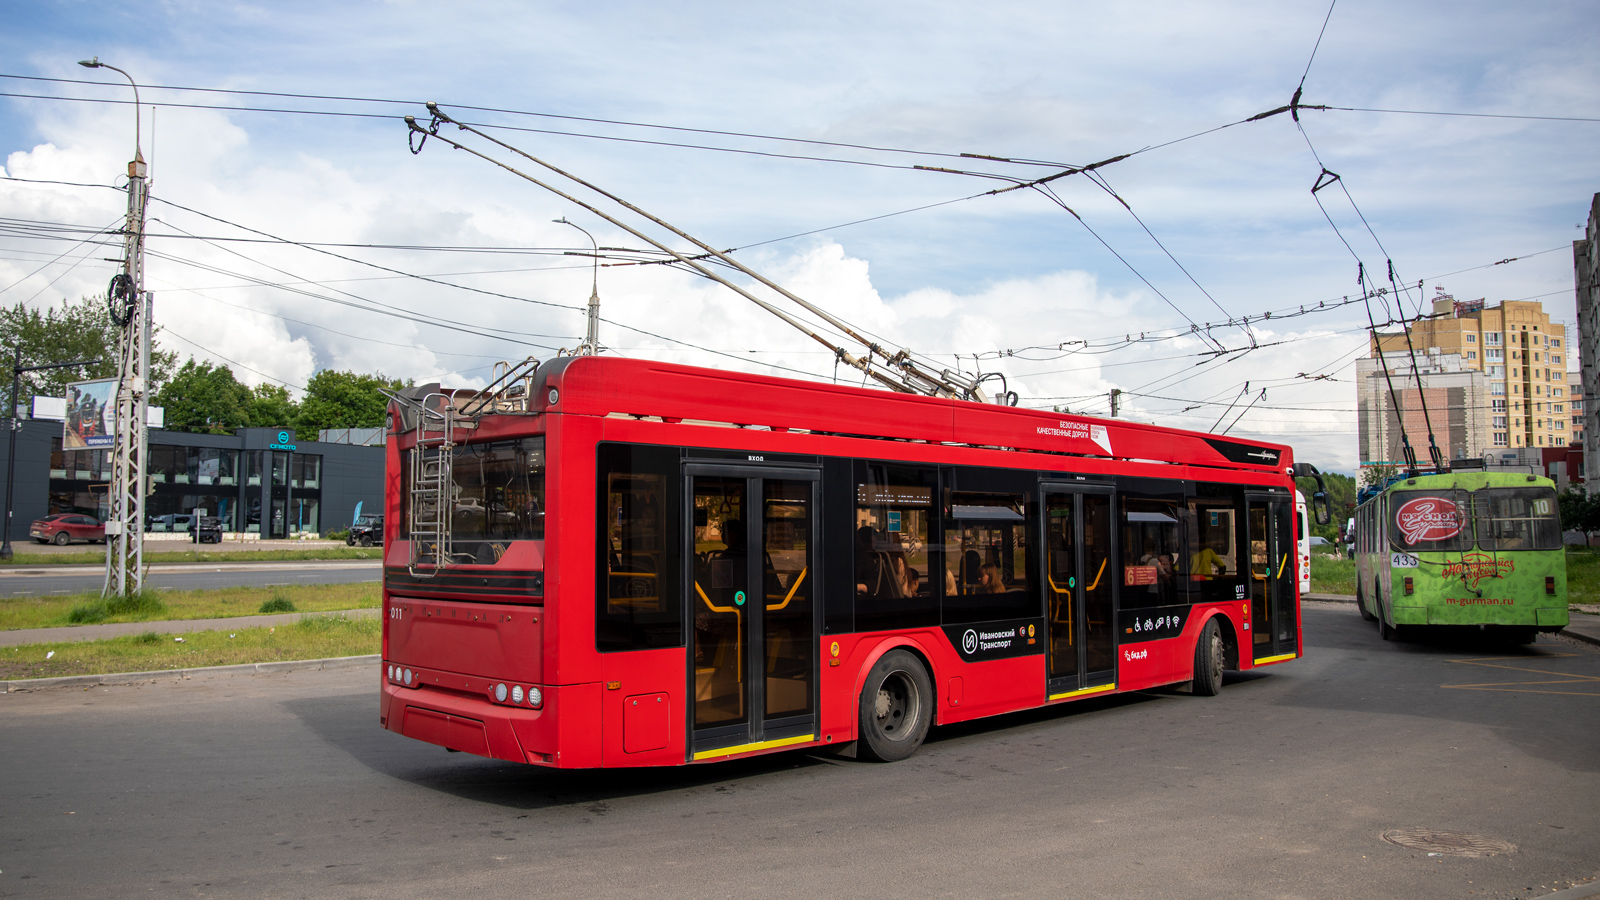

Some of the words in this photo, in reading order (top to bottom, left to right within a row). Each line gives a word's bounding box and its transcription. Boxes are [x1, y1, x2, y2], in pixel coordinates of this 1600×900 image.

[1060, 421, 1088, 430] БЕЗОПАСНЫЕ
[1037, 427, 1071, 437] КАЧЕСТВЕННЫЕ
[1533, 500, 1549, 515] 10
[1393, 555, 1418, 566] 433
[1127, 570, 1134, 585] 6
[1235, 584, 1245, 593] 011
[1446, 598, 1514, 606] m-gurman.ru
[390, 607, 402, 619] 011
[409, 606, 504, 623] АДМИРАЛ
[980, 629, 1015, 640] Ивановский
[980, 640, 1011, 650] Транспорт
